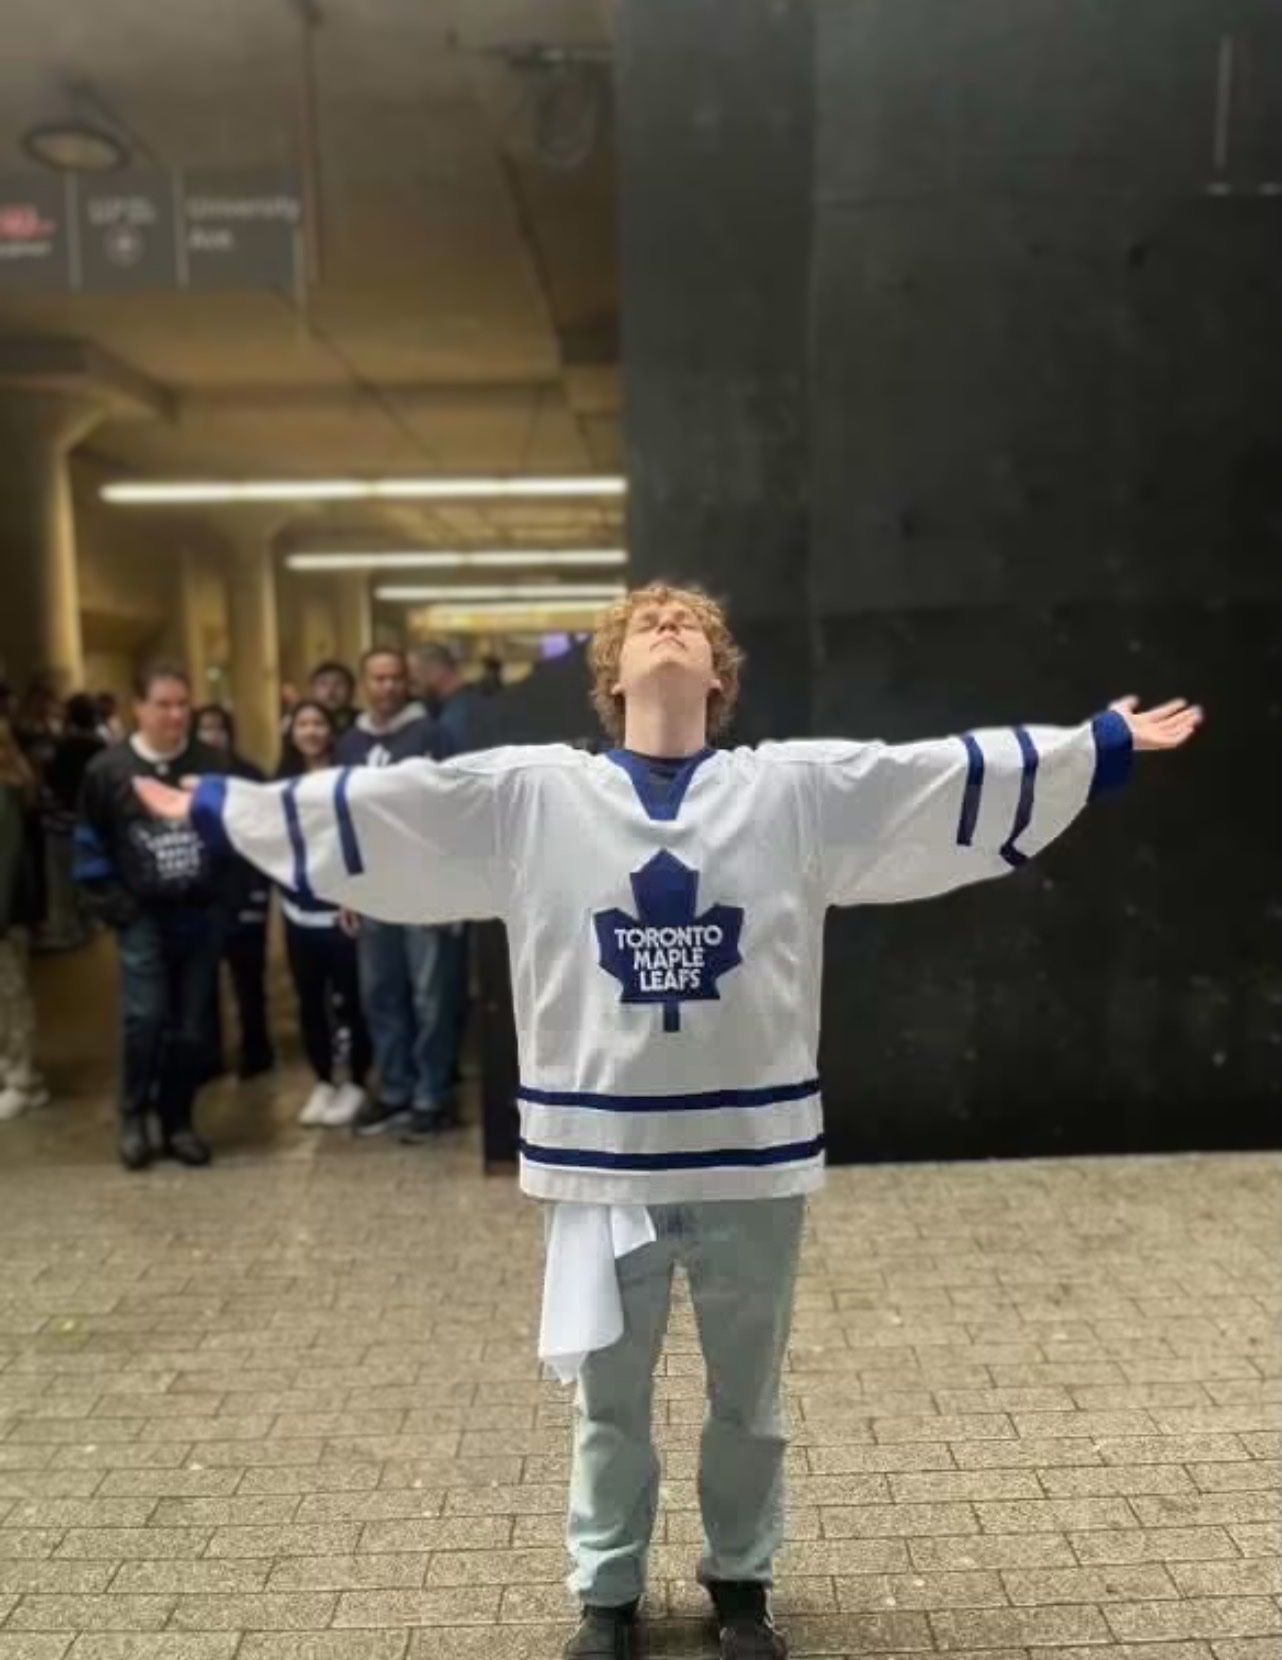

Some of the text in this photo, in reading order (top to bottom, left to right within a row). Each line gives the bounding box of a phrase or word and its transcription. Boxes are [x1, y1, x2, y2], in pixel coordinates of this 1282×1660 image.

[614, 925, 723, 950] TORONTO
[634, 947, 705, 970] MAPLE
[640, 968, 701, 992] LEAFS
